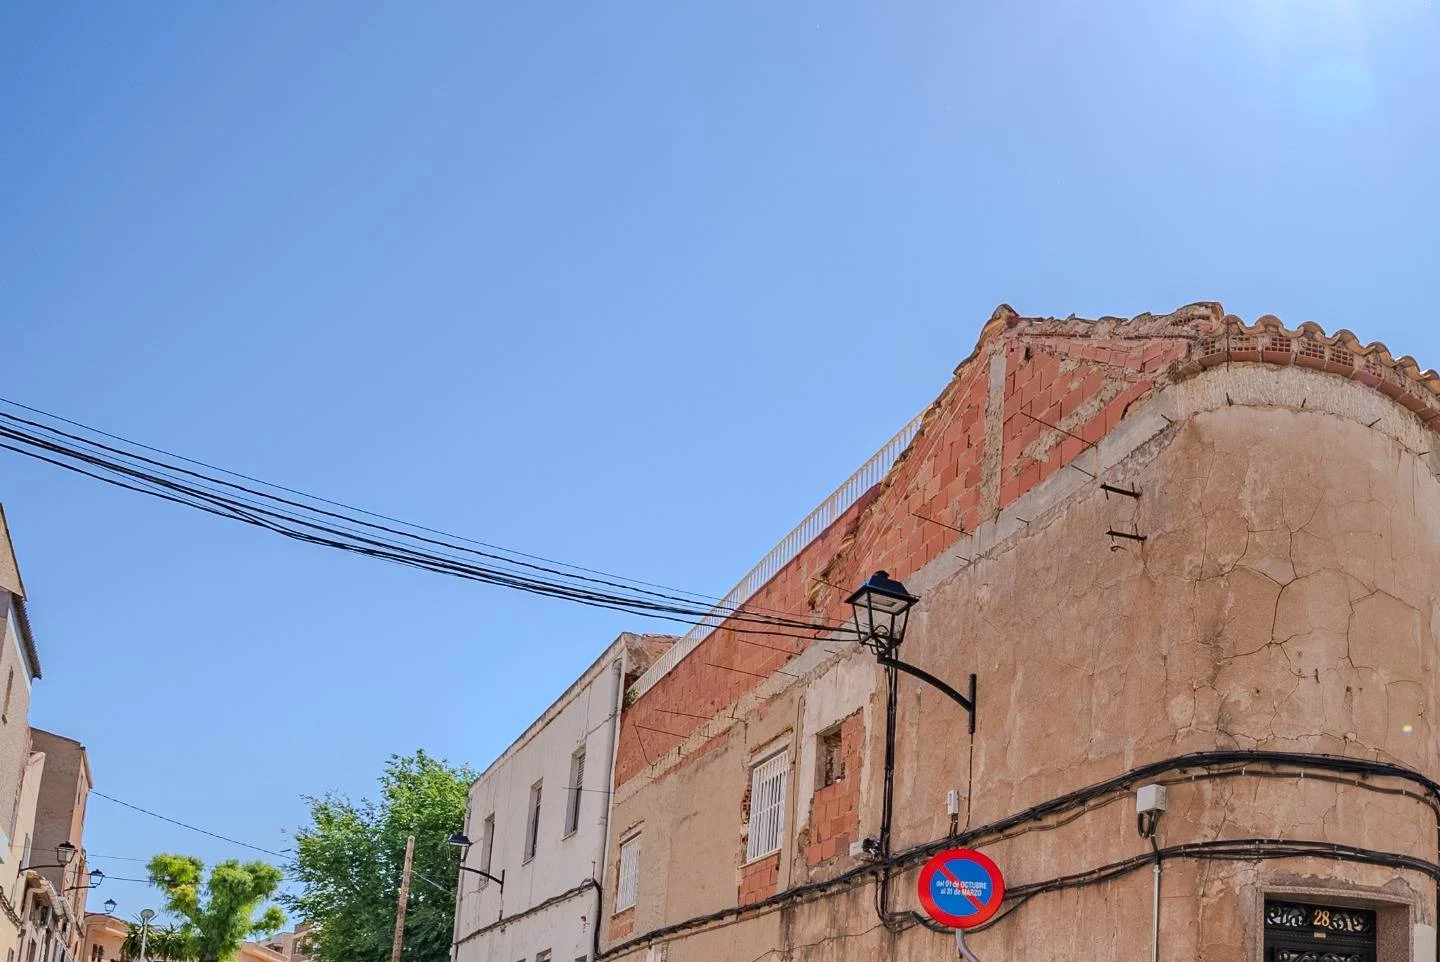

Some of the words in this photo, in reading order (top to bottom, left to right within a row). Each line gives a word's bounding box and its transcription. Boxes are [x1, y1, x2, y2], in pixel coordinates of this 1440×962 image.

[945, 880, 952, 888] 01
[960, 881, 987, 890] OCTUBRE
[953, 888, 961, 896] de
[961, 888, 982, 897] MARZO
[1313, 909, 1330, 927] 28
